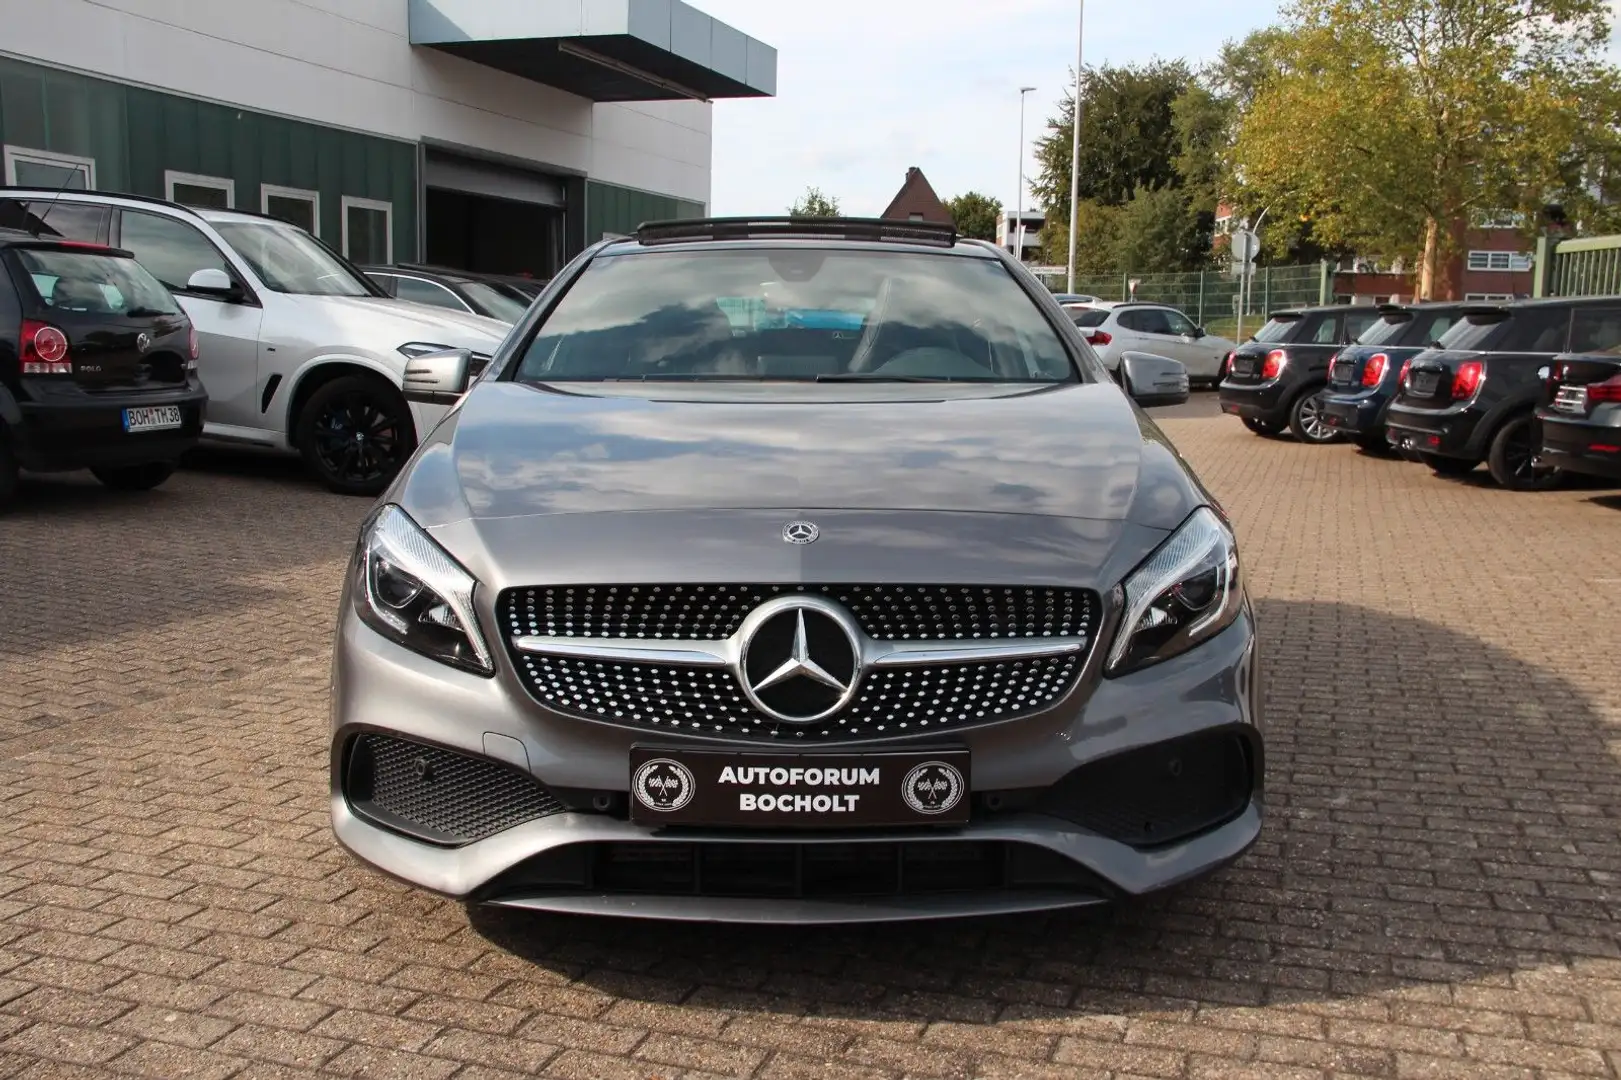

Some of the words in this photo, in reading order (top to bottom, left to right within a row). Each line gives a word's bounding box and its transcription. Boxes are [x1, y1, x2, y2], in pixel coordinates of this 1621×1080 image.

[128, 409, 149, 426] BOH
[718, 765, 881, 786] AUTOFORUM
[739, 793, 860, 813] BOCHOLT
